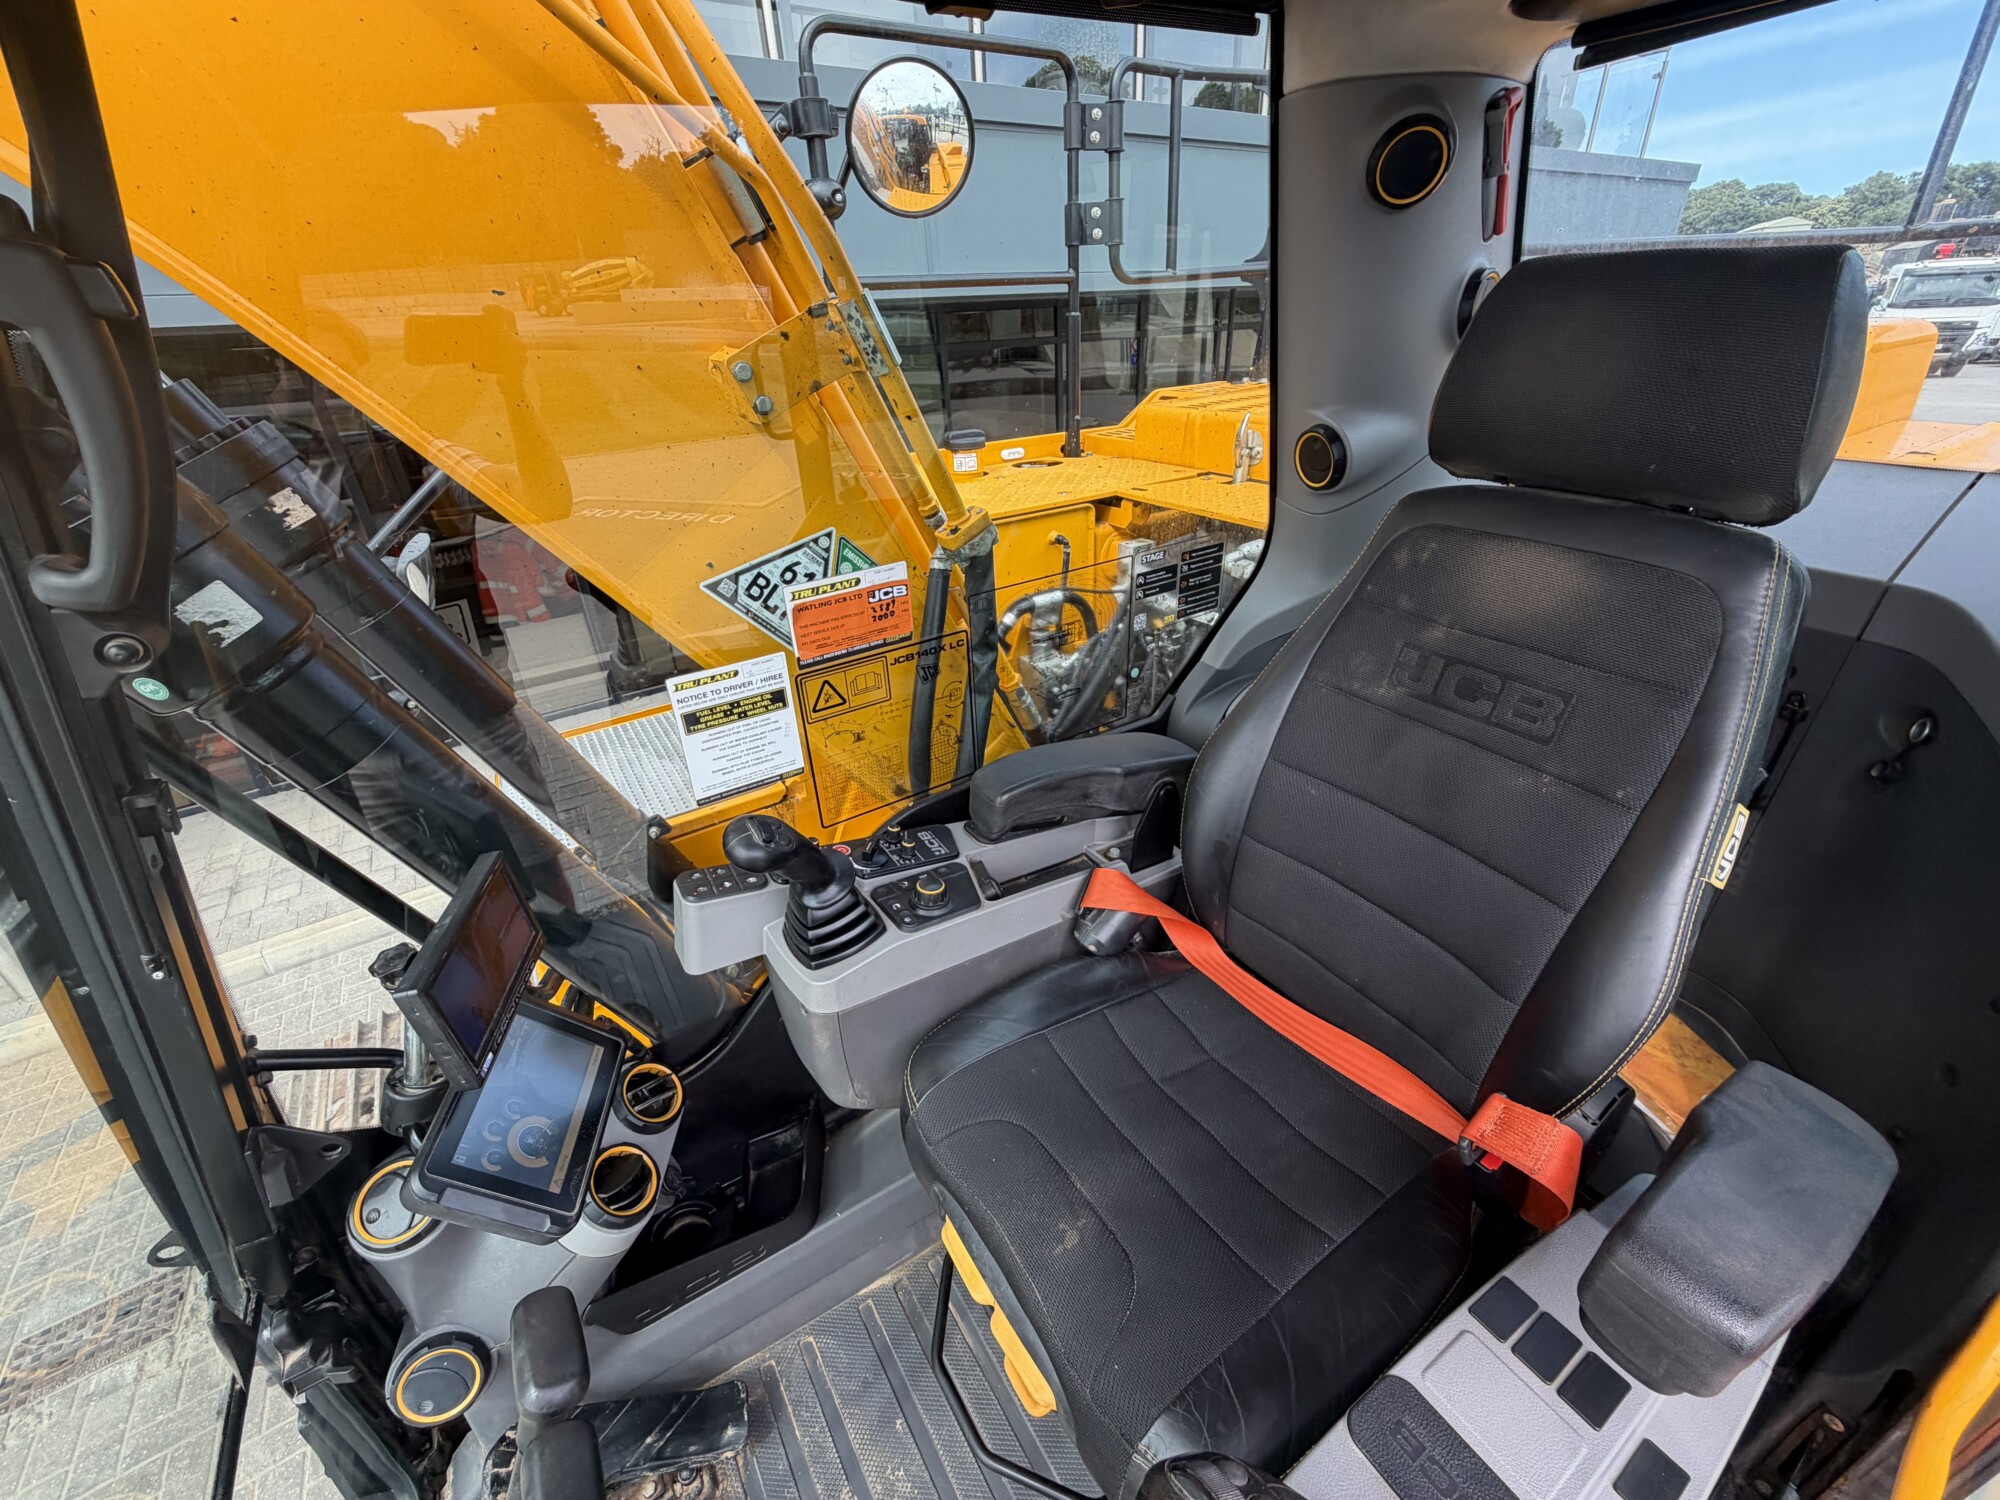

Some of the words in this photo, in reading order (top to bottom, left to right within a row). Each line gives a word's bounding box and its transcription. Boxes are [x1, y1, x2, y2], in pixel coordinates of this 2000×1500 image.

[1141, 551, 1165, 563] STAGE
[793, 590, 816, 600] TRU
[819, 579, 857, 594] PLANT
[868, 585, 907, 603] JCB
[797, 600, 832, 613] WATLING
[950, 638, 965, 648] LC
[676, 680, 699, 690] TRU
[700, 670, 736, 685] PLANT
[921, 665, 940, 683] JCB
[140, 683, 159, 692] OK
[677, 691, 708, 705] NOTICE
[724, 681, 754, 693] DRIVER
[761, 673, 783, 683] HIREE
[1391, 645, 1566, 740] JCB
[696, 709, 712, 717] FUEL
[713, 704, 732, 714] LEVEL
[740, 696, 762, 706] ENGINE
[700, 712, 724, 723] GREASE
[733, 705, 753, 714] WATER
[754, 700, 772, 709] LEVEL
[690, 722, 706, 731] TYRE
[707, 715, 738, 727] PRESSURE
[747, 707, 767, 716] WHEEL
[917, 831, 945, 855] JCB
[1716, 813, 1746, 880] JCB
